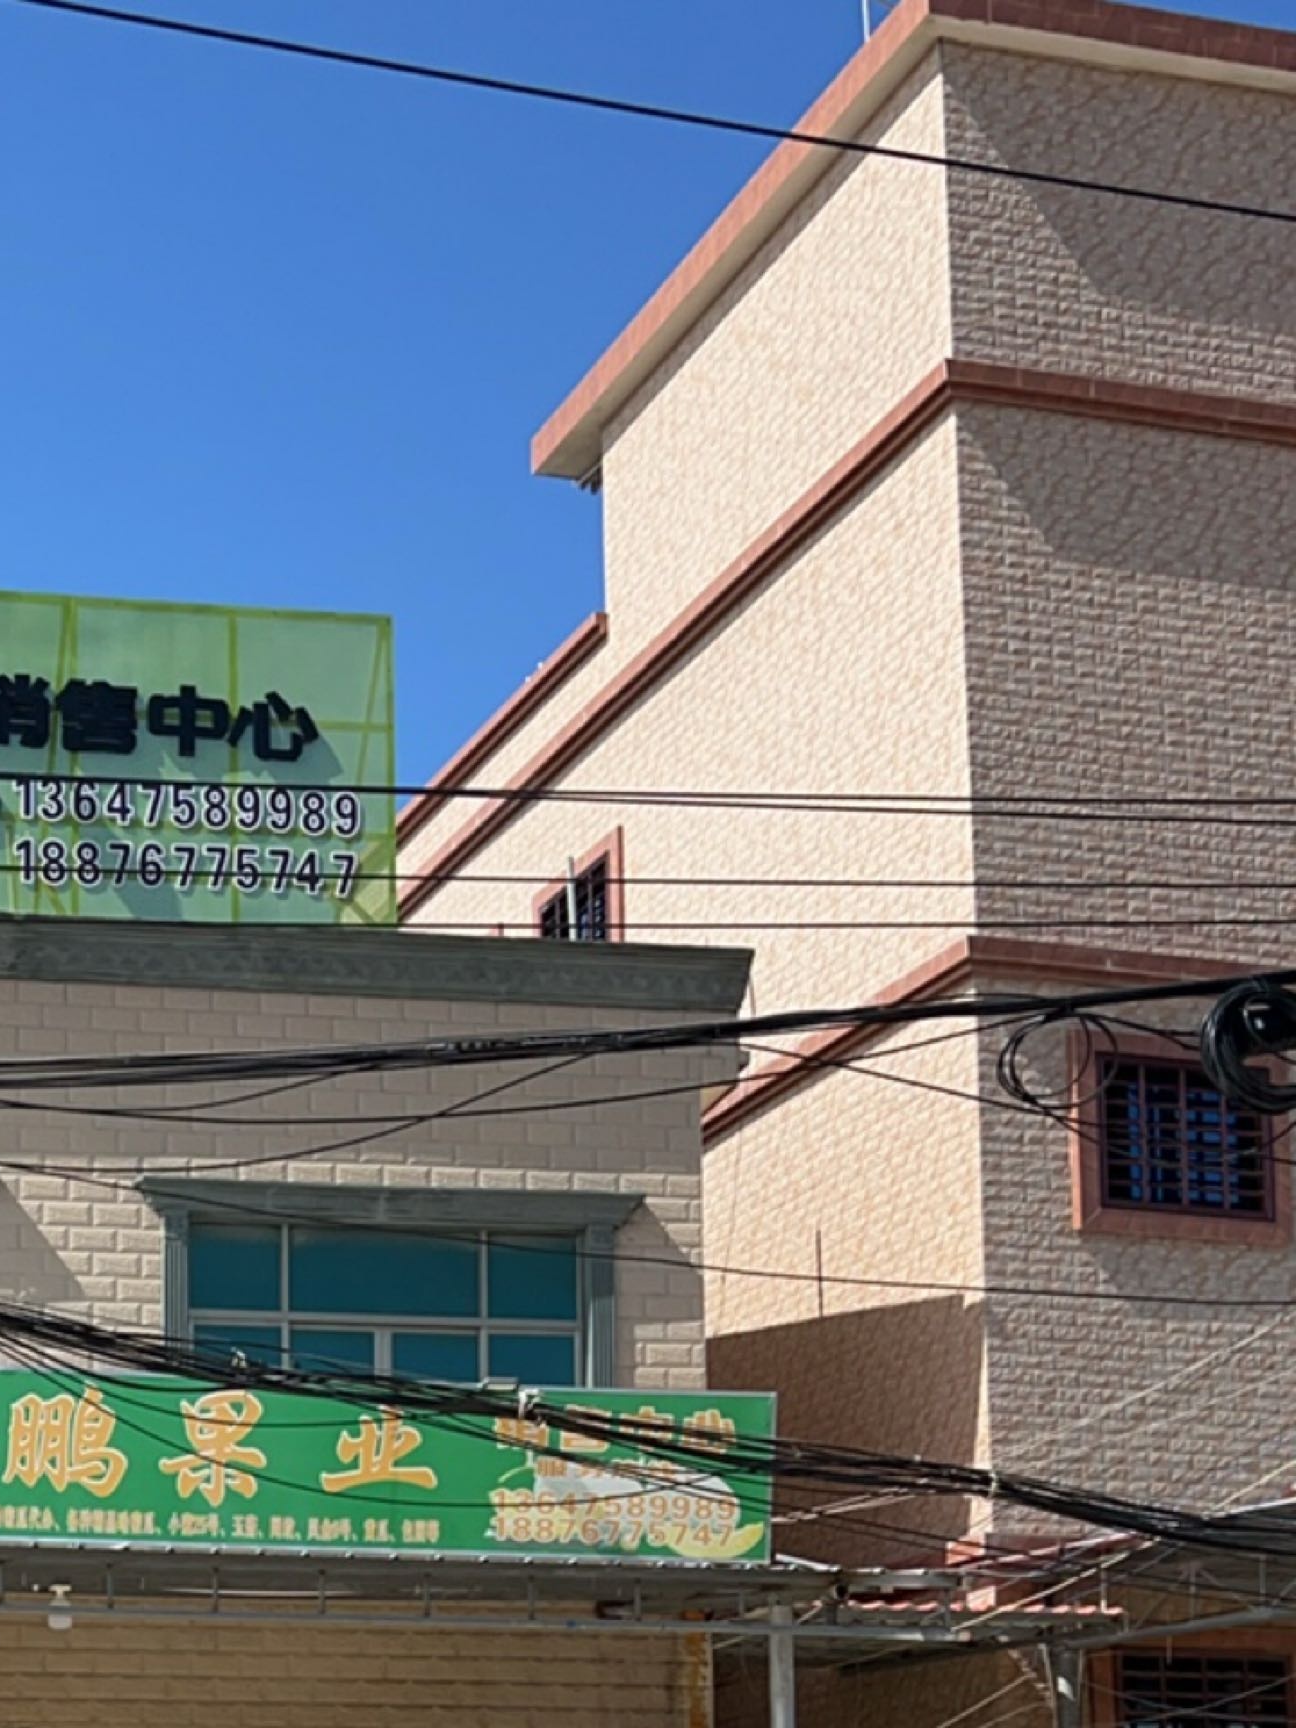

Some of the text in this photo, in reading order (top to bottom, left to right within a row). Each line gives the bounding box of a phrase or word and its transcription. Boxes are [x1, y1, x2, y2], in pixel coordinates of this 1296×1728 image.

[12, 776, 361, 840] 13647589989
[13, 837, 360, 899] 18876775747
[493, 1516, 736, 1547] 18876775747
